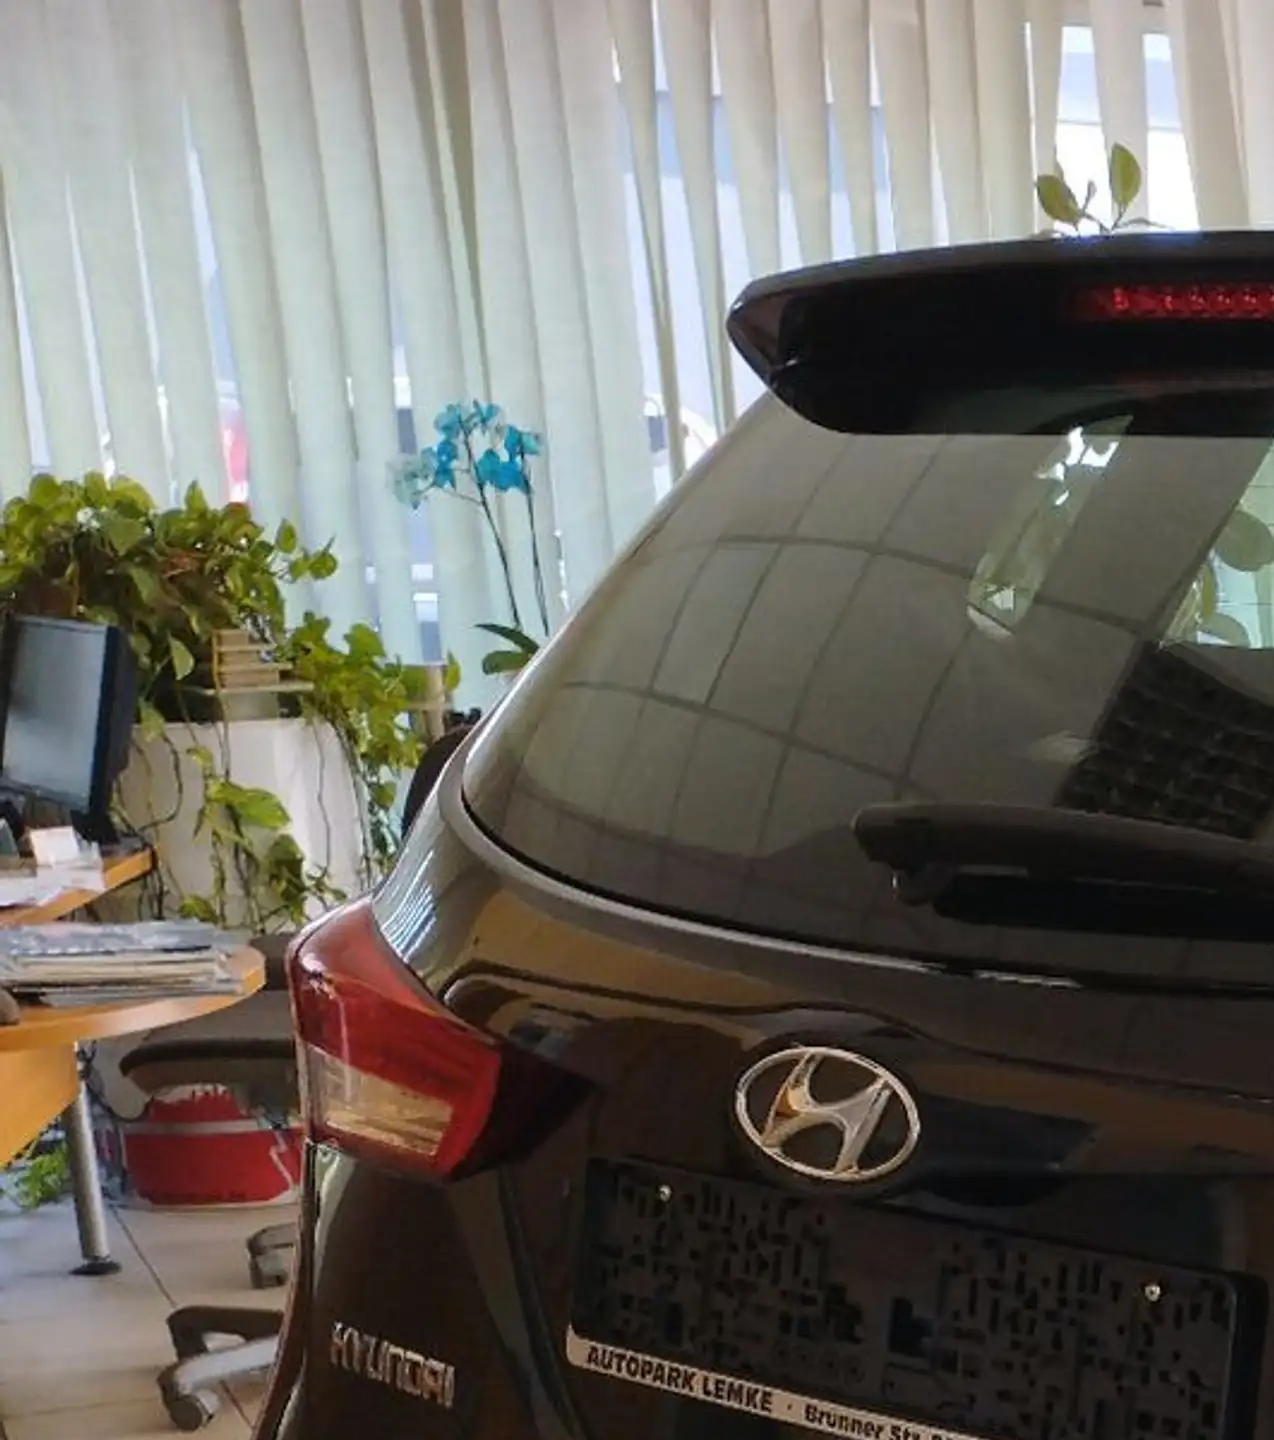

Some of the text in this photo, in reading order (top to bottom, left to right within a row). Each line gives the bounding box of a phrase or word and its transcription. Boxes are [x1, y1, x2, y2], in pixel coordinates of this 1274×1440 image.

[586, 1344, 696, 1391] AUTOPARK
[702, 1376, 775, 1413] LEMKE
[804, 1403, 885, 1440] Brunner
